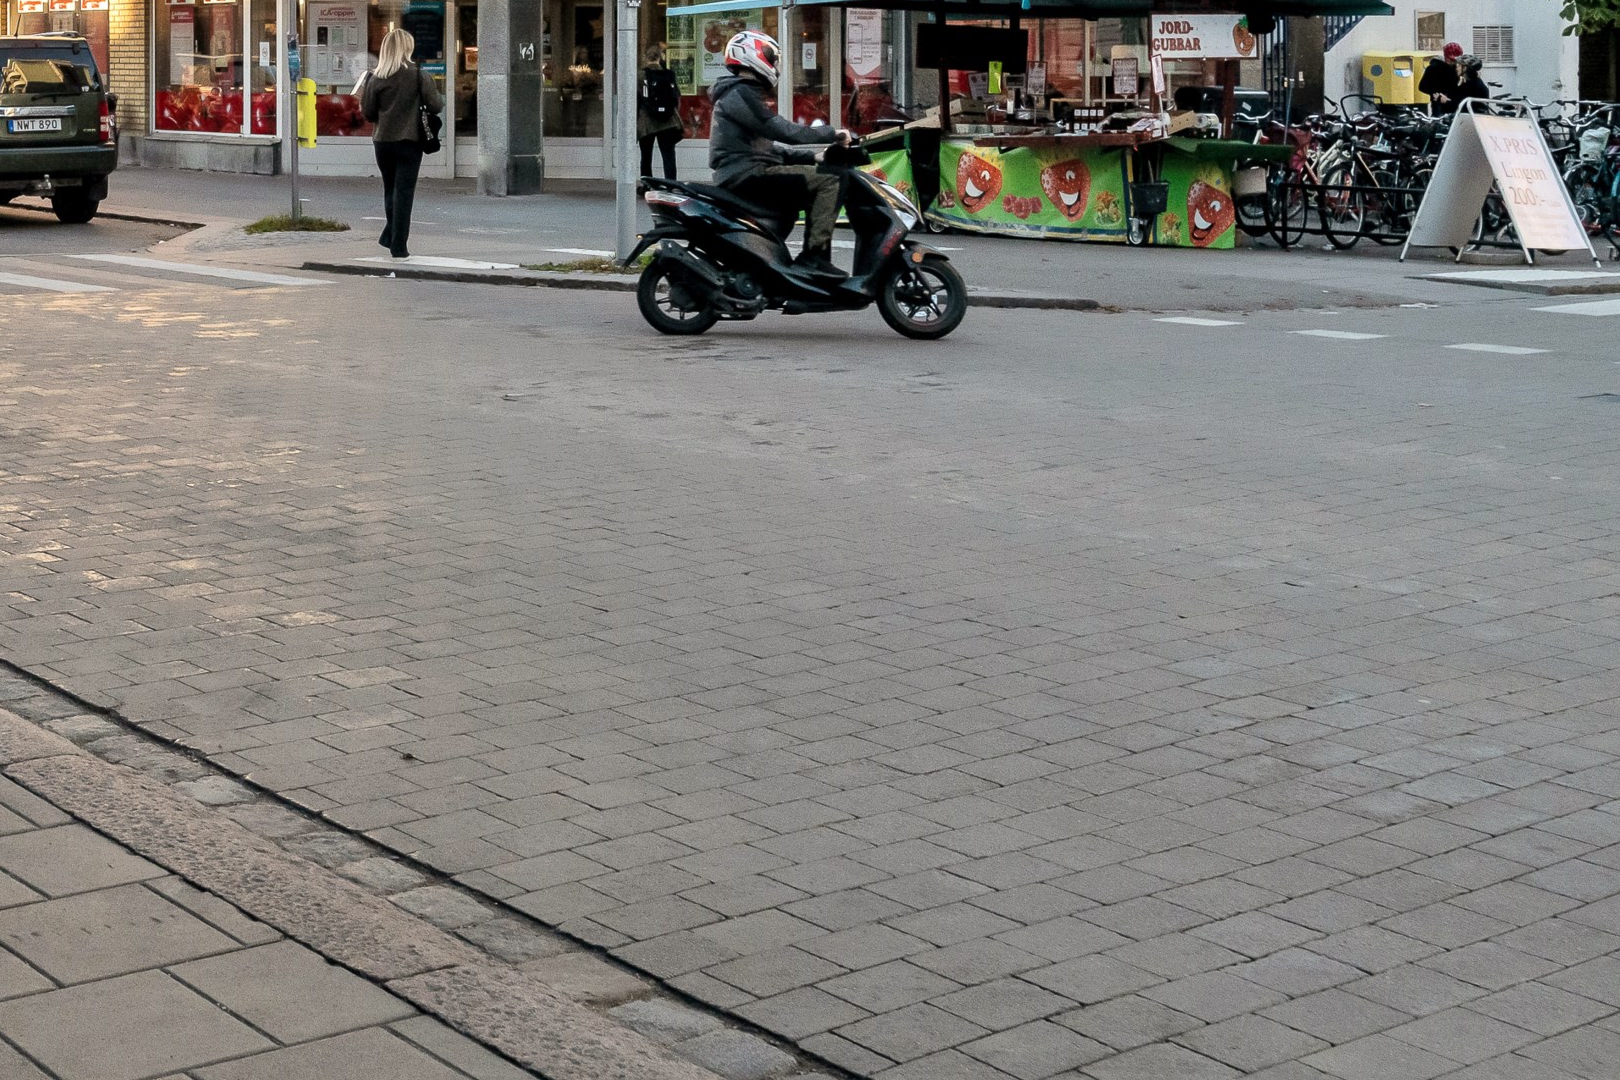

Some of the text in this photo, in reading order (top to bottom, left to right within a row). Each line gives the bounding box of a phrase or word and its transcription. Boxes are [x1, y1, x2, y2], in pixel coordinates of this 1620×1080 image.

[1159, 21, 1194, 34] JORD-
[1153, 37, 1201, 51] GUBBAR
[17, 120, 57, 130] NWT 890
[1501, 161, 1547, 184] Lingon
